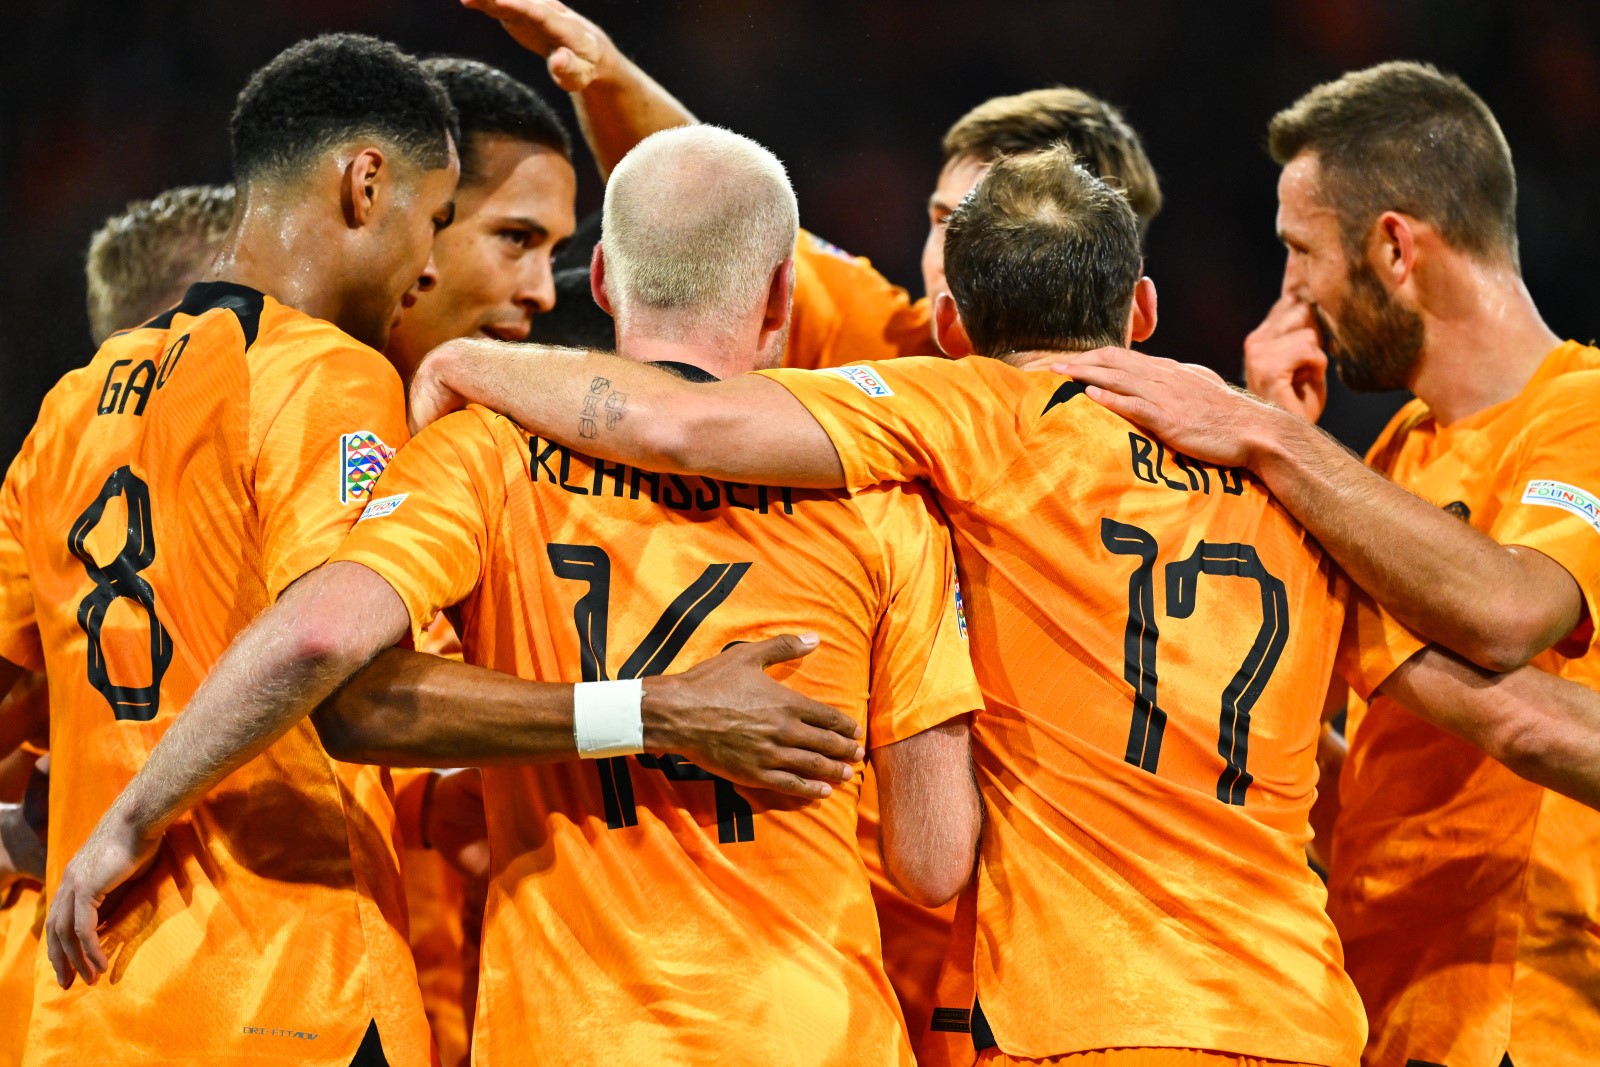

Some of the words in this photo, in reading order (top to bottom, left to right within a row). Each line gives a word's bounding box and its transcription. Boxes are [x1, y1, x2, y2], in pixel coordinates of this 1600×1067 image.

[67, 465, 174, 721] 8
[1127, 431, 1244, 497] BLID
[546, 542, 755, 845] 14
[1101, 517, 1290, 806] 17
